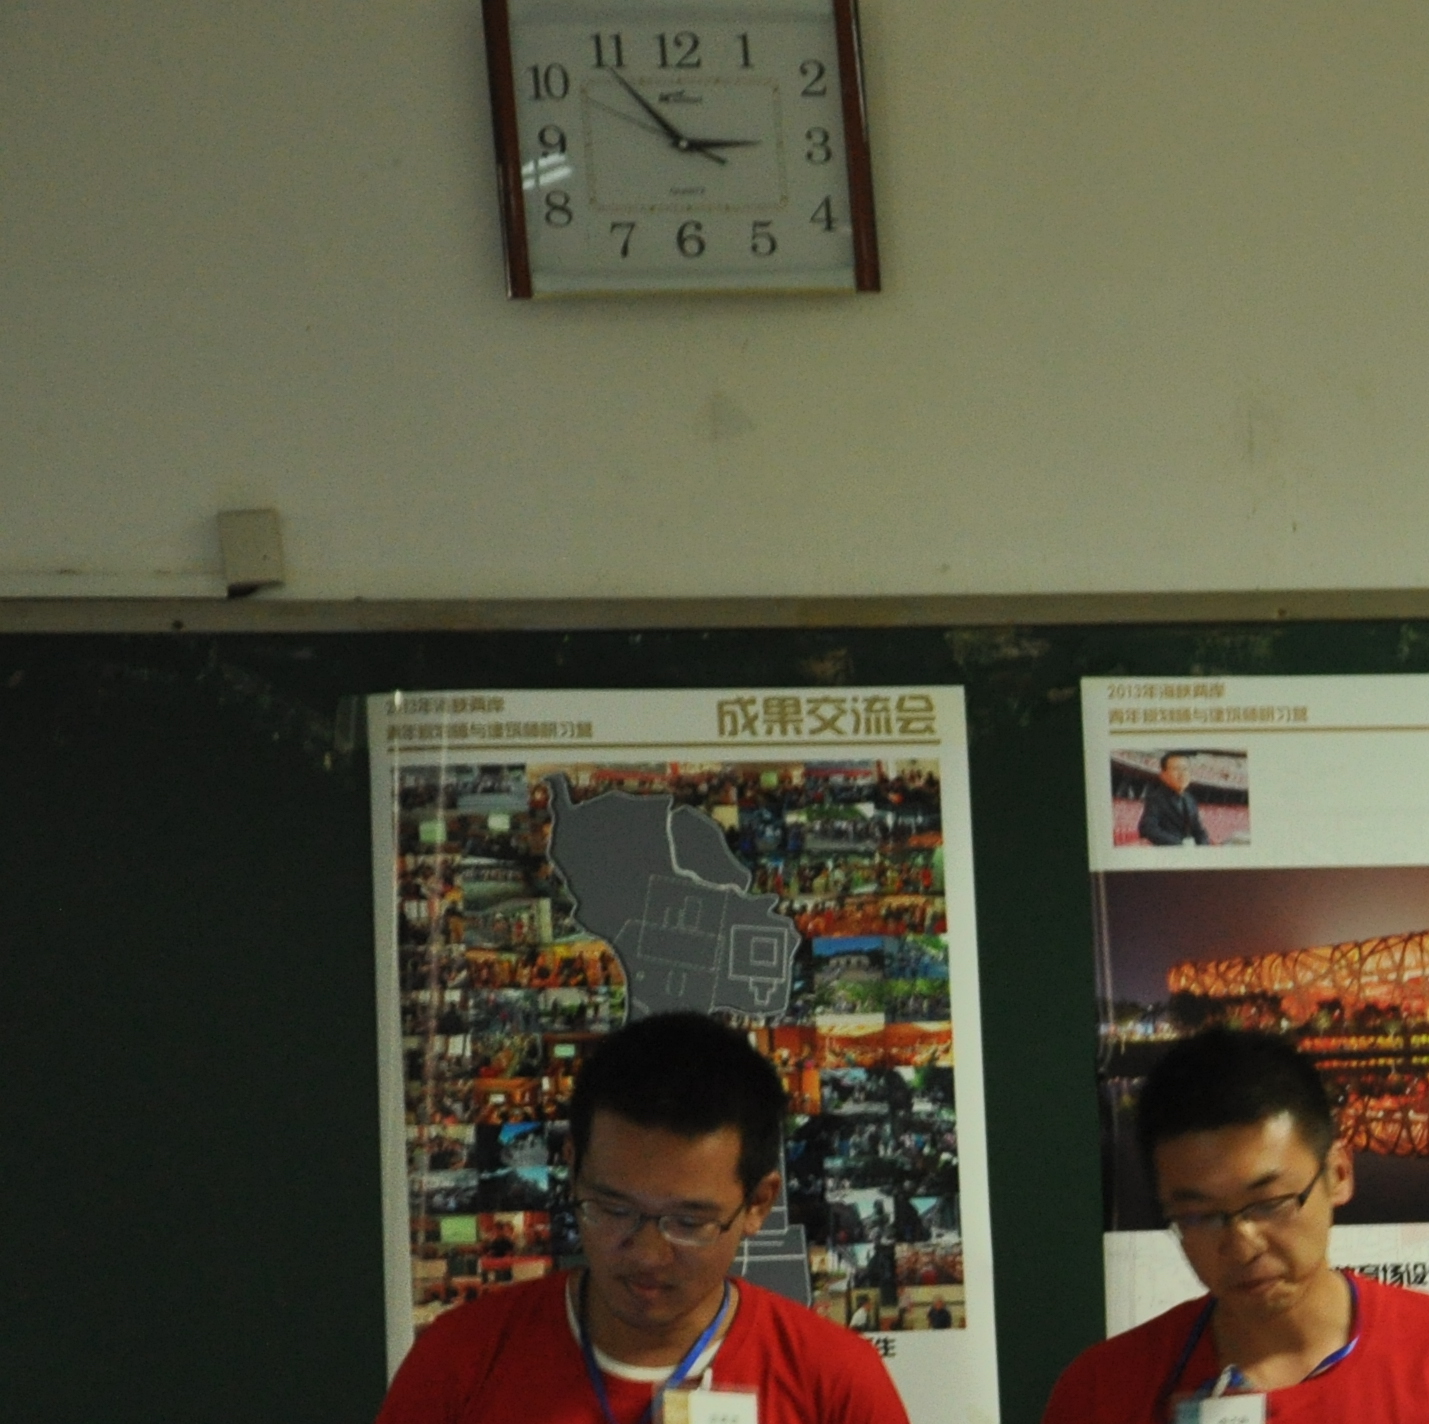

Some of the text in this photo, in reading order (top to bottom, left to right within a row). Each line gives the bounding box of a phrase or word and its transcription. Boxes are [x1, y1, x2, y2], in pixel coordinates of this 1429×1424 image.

[590, 32, 626, 69] 11
[657, 31, 701, 69] 12
[738, 32, 755, 68] 1
[528, 63, 569, 101] 10
[800, 60, 828, 97] 2
[538, 125, 568, 159] 9
[805, 127, 832, 164] 3
[545, 191, 573, 228] 8
[810, 196, 838, 232] 4
[610, 222, 637, 258] 7
[676, 220, 706, 258] 6
[751, 221, 777, 257] 5
[716, 693, 938, 738] 成果交流会
